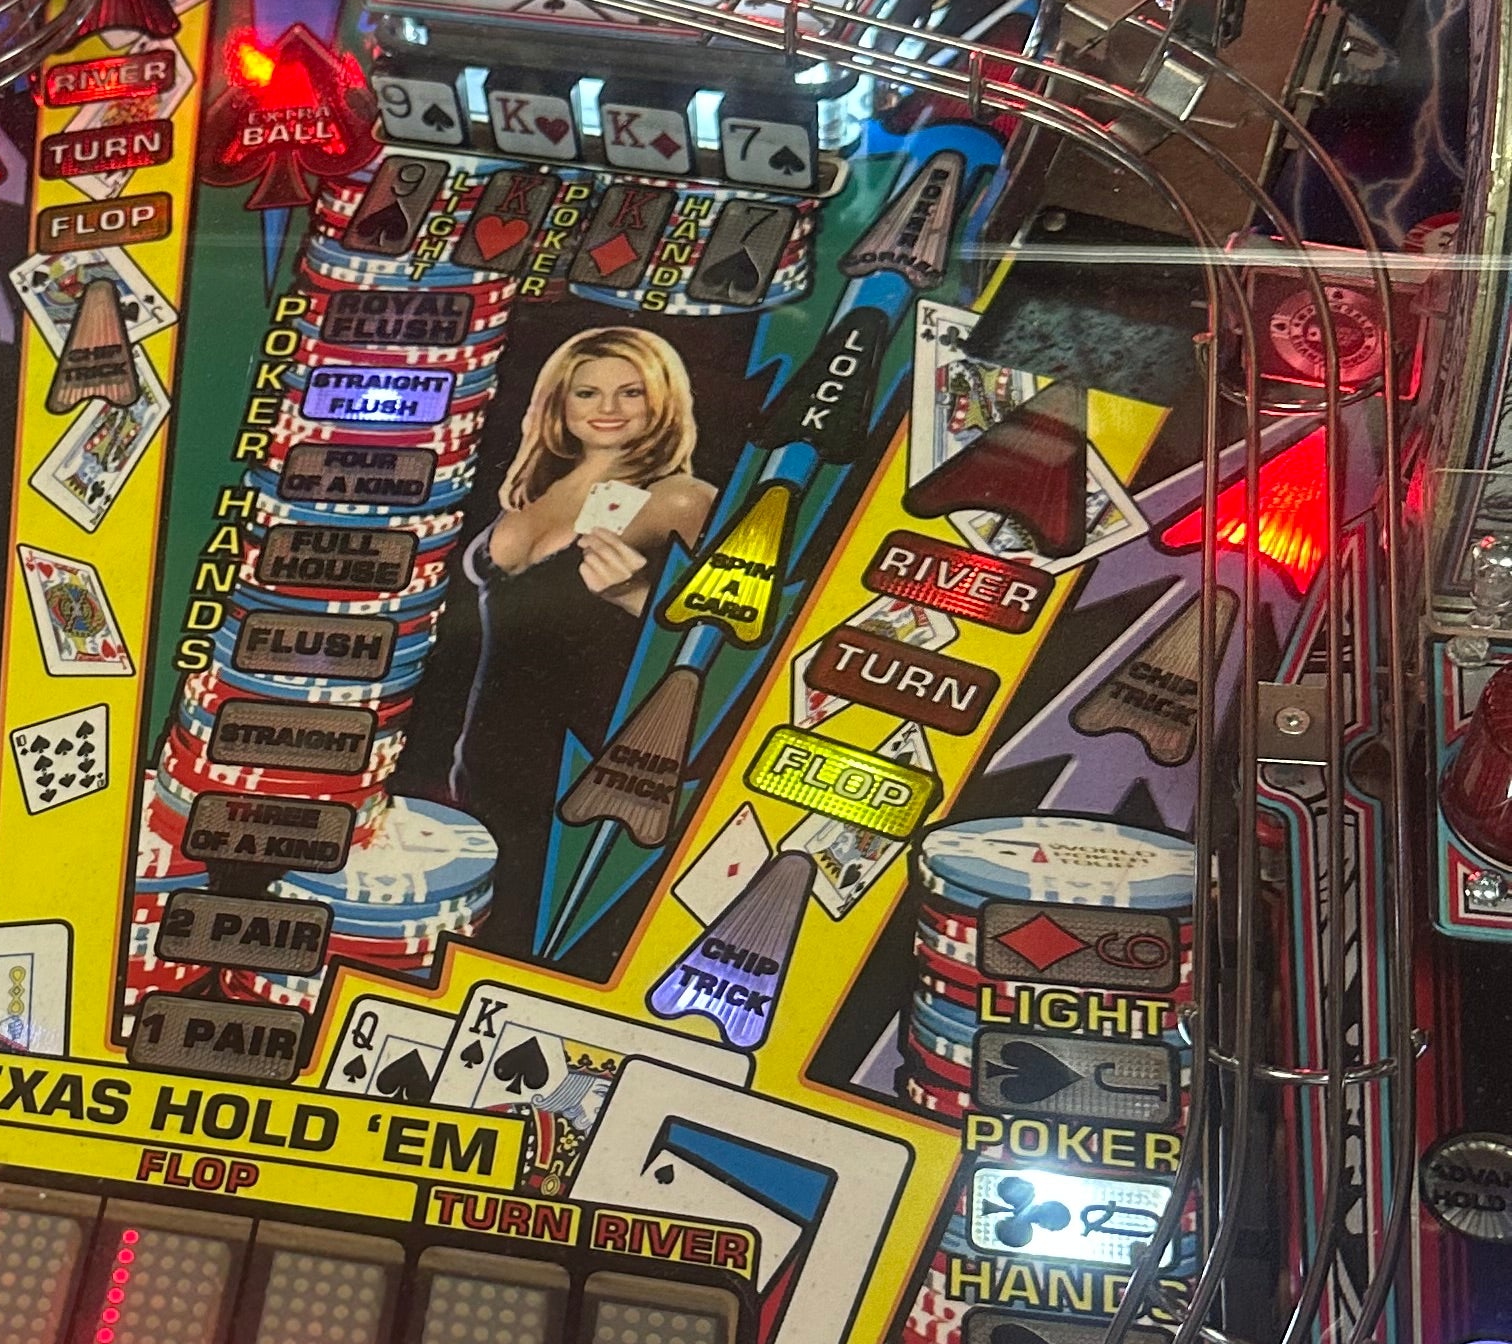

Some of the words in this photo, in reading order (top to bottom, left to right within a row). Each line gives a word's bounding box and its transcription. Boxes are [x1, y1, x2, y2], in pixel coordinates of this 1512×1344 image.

[53, 58, 170, 93] RIVER
[379, 83, 414, 119] 9
[496, 97, 535, 136] K
[48, 129, 164, 166] TURN
[241, 119, 336, 149] BALL
[607, 110, 646, 150] K
[729, 124, 763, 162] 7
[397, 162, 428, 200] 9
[497, 175, 542, 217] K
[50, 204, 157, 239] FLOP
[409, 171, 473, 283] LIGHT
[615, 189, 659, 232] K
[739, 205, 779, 244] 7
[520, 184, 591, 299] POKER
[641, 197, 712, 313] HANDS
[335, 290, 464, 319] ROYAL
[921, 307, 938, 326] K
[330, 314, 458, 345] FLUSH
[235, 294, 309, 462] POKER
[311, 370, 451, 395] STRAIGHT
[801, 328, 865, 432] LOCK
[328, 393, 420, 419] FLUSH
[323, 448, 400, 472] FOUR
[287, 472, 324, 495] OF
[327, 474, 352, 496] A
[355, 474, 426, 501] KIND
[289, 528, 381, 558] FULL
[176, 488, 255, 673] HANDS
[269, 552, 403, 588] HOUSE
[879, 545, 1041, 614] RIVER
[684, 593, 758, 623] CARD
[244, 626, 384, 662] FLUSH
[832, 642, 981, 711] TURN
[218, 721, 367, 756] STRAIGHT
[612, 745, 680, 774] CHIP
[771, 745, 914, 810] FLOP
[591, 765, 677, 804] TRICK
[225, 800, 322, 830] THREE
[189, 829, 223, 851] OF
[233, 833, 259, 855] A
[264, 836, 340, 864] KIND
[166, 908, 196, 939] 2
[209, 912, 324, 954] PAIR
[700, 938, 779, 977] CHIP
[678, 961, 773, 1017] TRICK
[469, 997, 509, 1038] K
[981, 986, 1171, 1035] LIGHT
[140, 1012, 166, 1045] 1
[182, 1017, 298, 1061] PAIR
[351, 1011, 379, 1051] Q
[149, 1086, 340, 1153] HOLD
[964, 1115, 1182, 1170] POKER
[137, 1148, 259, 1194] FLOP
[431, 1189, 574, 1242] TURN
[593, 1211, 751, 1270] RIVER
